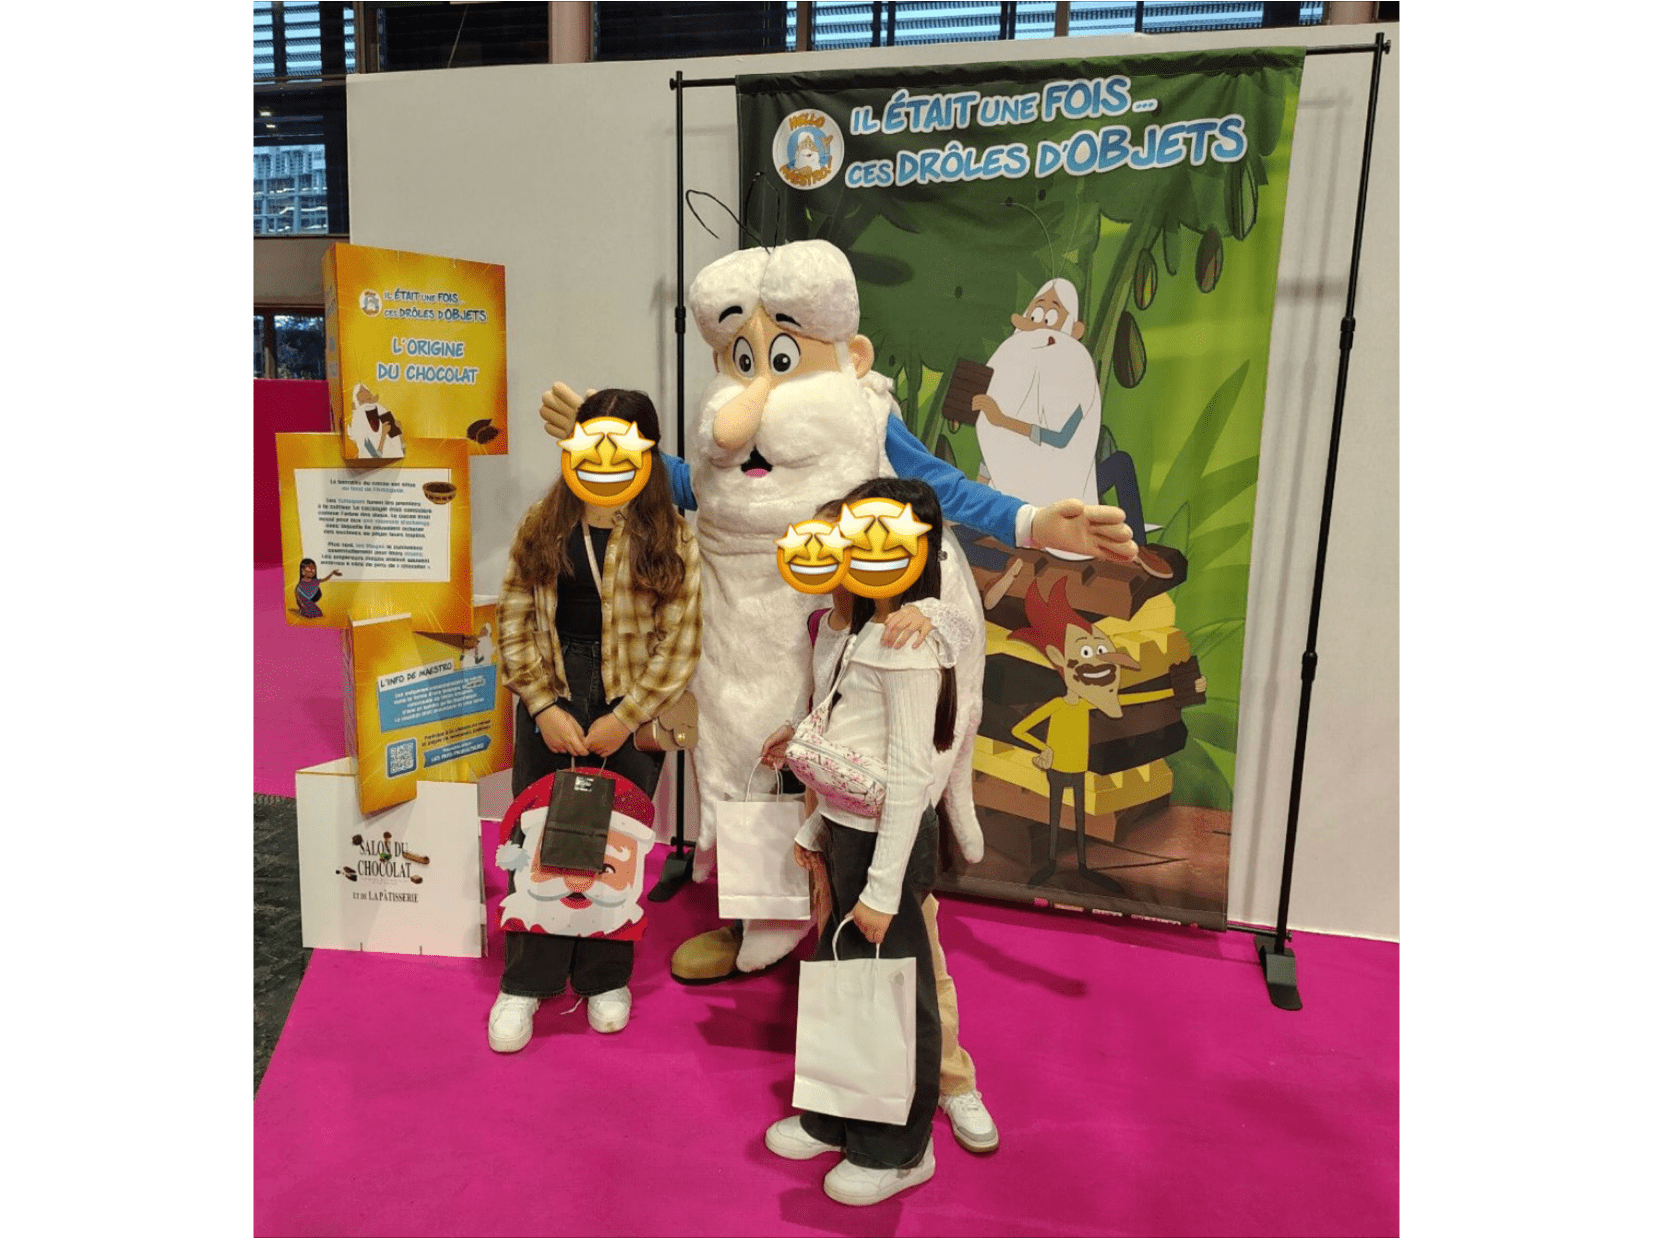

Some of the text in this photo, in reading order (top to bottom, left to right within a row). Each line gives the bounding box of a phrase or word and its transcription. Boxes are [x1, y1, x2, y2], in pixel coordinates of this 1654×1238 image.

[788, 112, 826, 131] HELLO
[851, 106, 880, 135] IL
[881, 89, 981, 134] ÉTAIT
[977, 93, 1040, 126] UNE
[845, 114, 1247, 188] CES DRÔLES D'OBJETS
[384, 290, 393, 300] IL
[394, 288, 420, 301] ÉTAIT
[422, 294, 436, 302] UNE
[384, 309, 399, 318] CES
[399, 306, 434, 319] DRÔLES
[392, 337, 464, 358] L'ORIGINE
[377, 362, 479, 384] DU CHOCOLAT
[380, 662, 453, 688] L'INFO DE MAESTRO
[394, 841, 409, 857] DU
[357, 860, 411, 878] CHOCOLAT
[368, 891, 378, 901] LA
[379, 889, 419, 903] PÂTISSERIE
